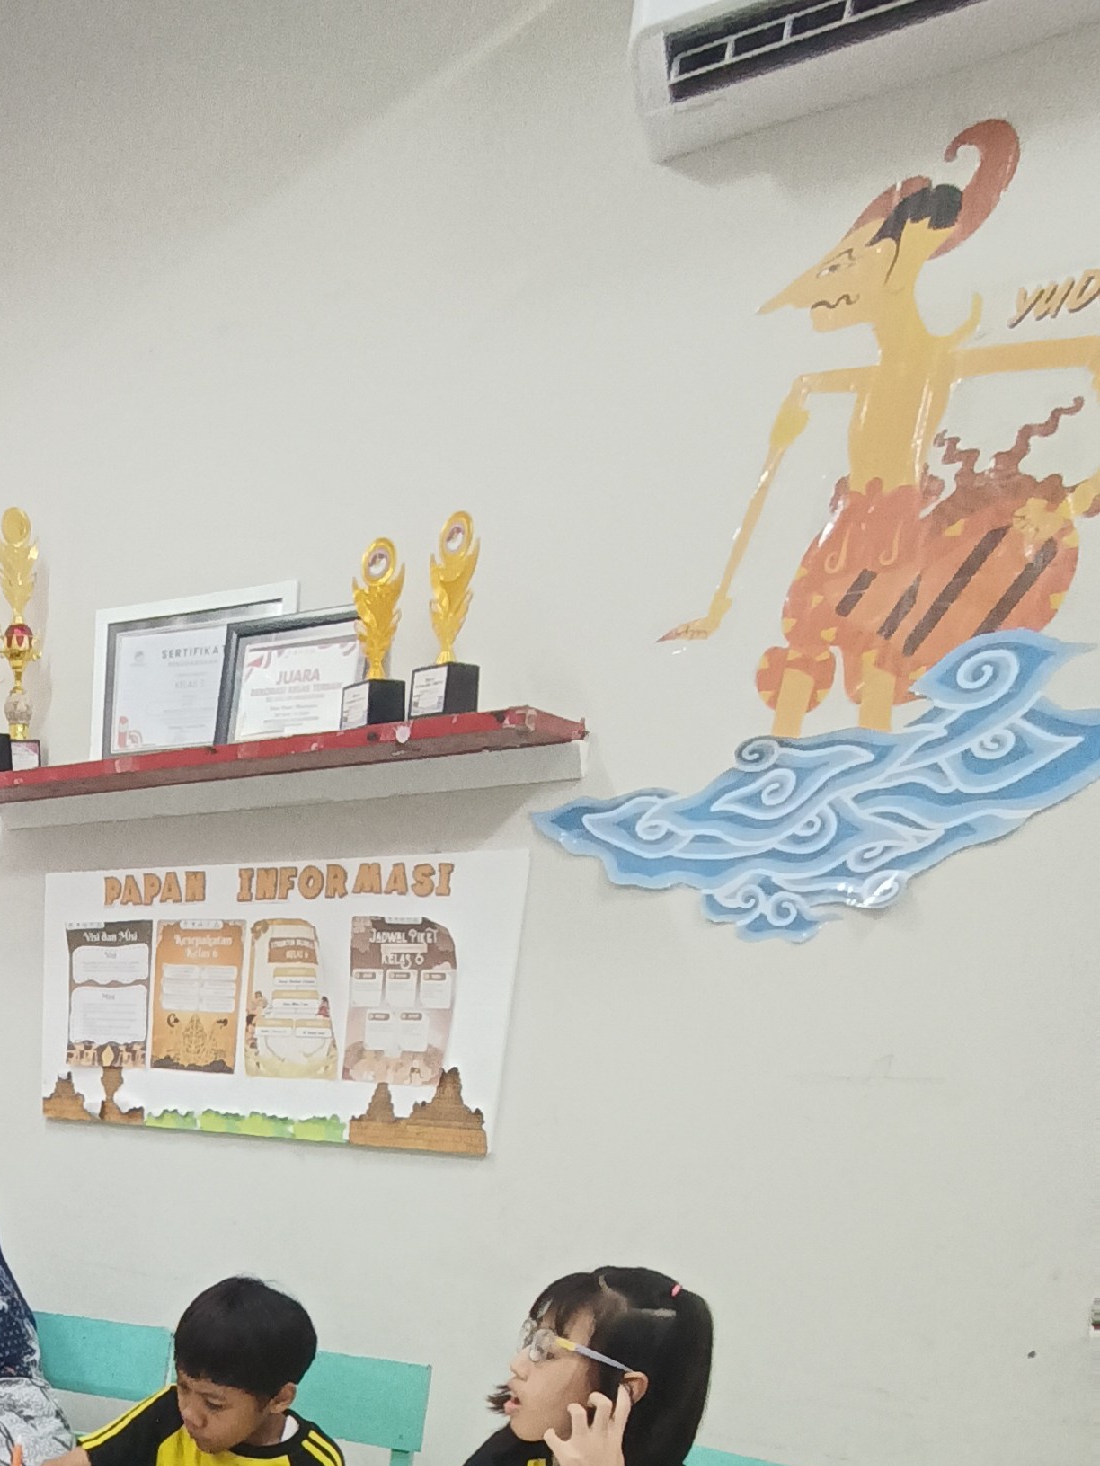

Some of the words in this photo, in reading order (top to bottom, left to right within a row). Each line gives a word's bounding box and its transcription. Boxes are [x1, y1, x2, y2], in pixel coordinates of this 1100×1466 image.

[162, 645, 226, 660] SERTIFIKA
[276, 668, 321, 685] JUARA
[104, 870, 206, 906] PAPAN
[236, 862, 454, 903] INFORMASI
[369, 928, 407, 944] JADWAL
[414, 952, 425, 966] 6
